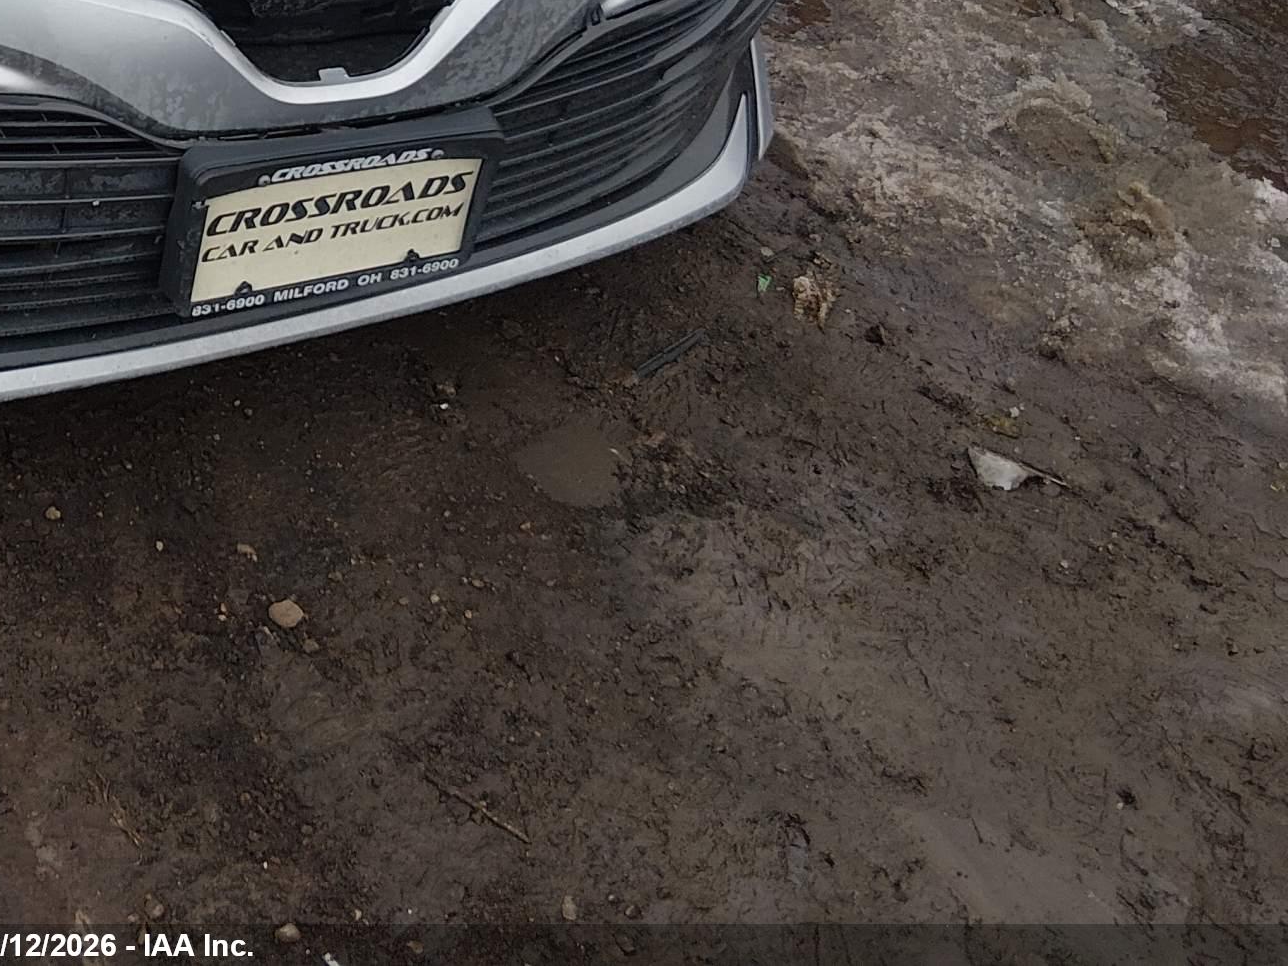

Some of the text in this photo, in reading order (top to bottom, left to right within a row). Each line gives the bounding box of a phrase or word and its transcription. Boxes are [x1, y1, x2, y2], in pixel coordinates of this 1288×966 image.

[271, 148, 432, 183] CROSSROADS
[202, 202, 465, 263] CAR AND TRUCK.COM
[206, 171, 474, 237] CROSSROADS
[191, 258, 460, 317] 831-6900 MILFORD OH 831-6900
